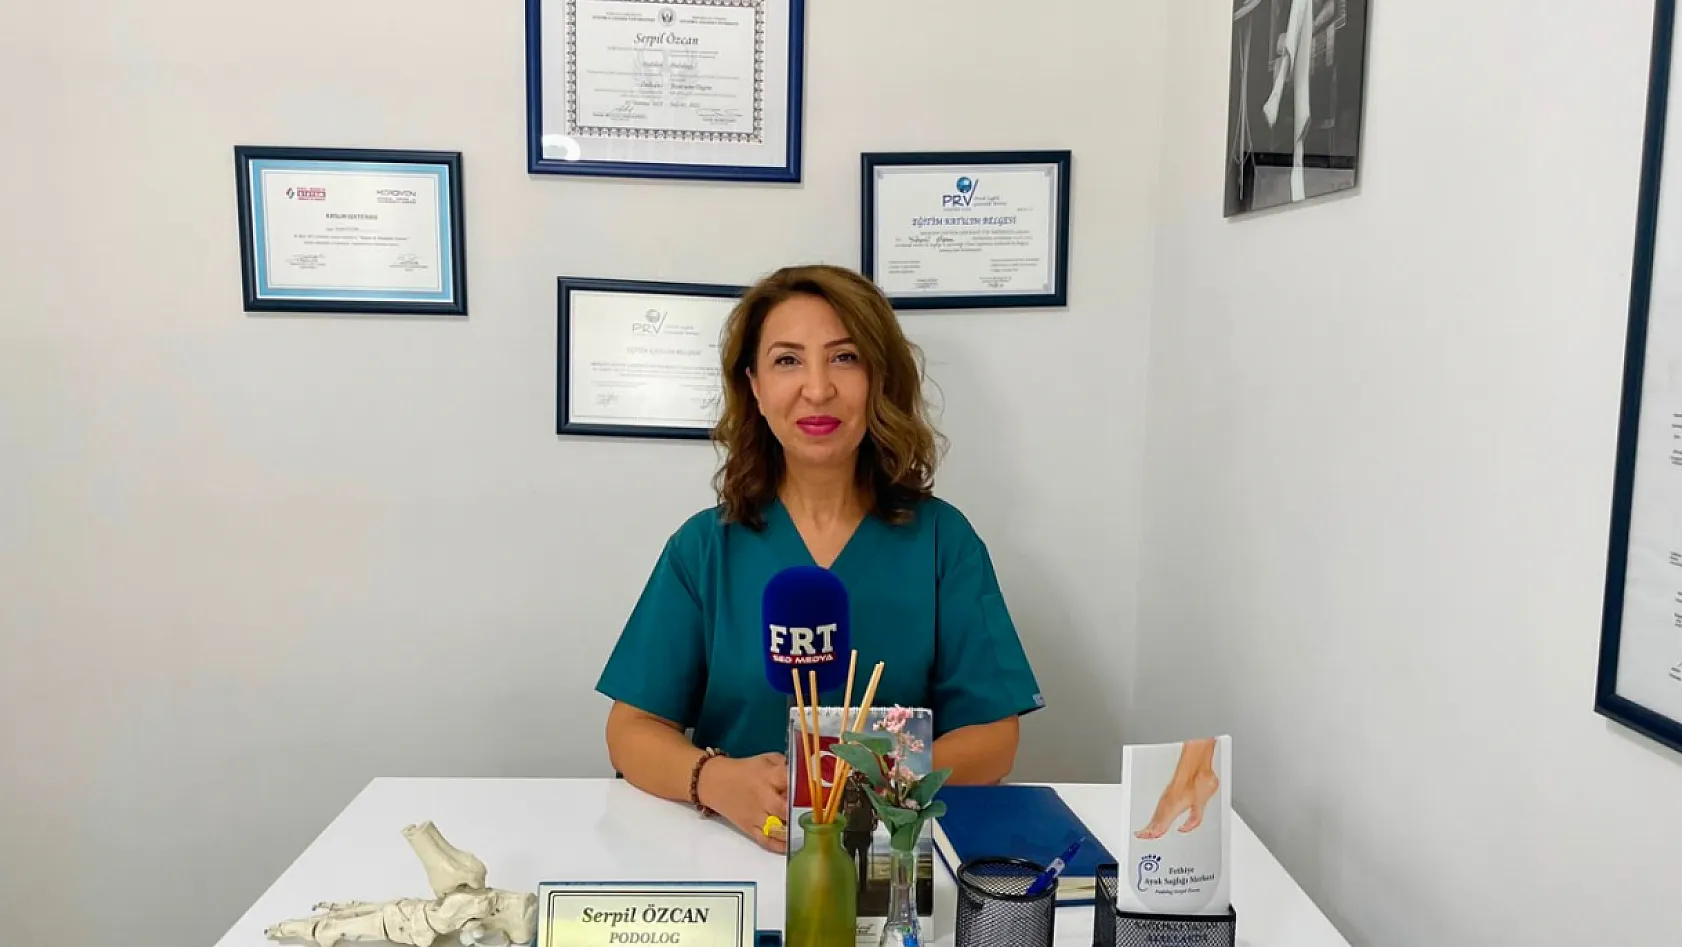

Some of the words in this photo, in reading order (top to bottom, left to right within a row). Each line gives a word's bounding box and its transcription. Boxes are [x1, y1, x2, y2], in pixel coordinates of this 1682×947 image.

[634, 32, 665, 47] Serpil
[666, 31, 699, 46] Özcan
[769, 622, 837, 655] FRT
[795, 655, 834, 664] MEDYA
[1168, 866, 1195, 876] Fethiye
[582, 907, 636, 926] Serpil
[642, 904, 710, 924] ÖZCAN
[609, 932, 681, 945] PODOLOG
